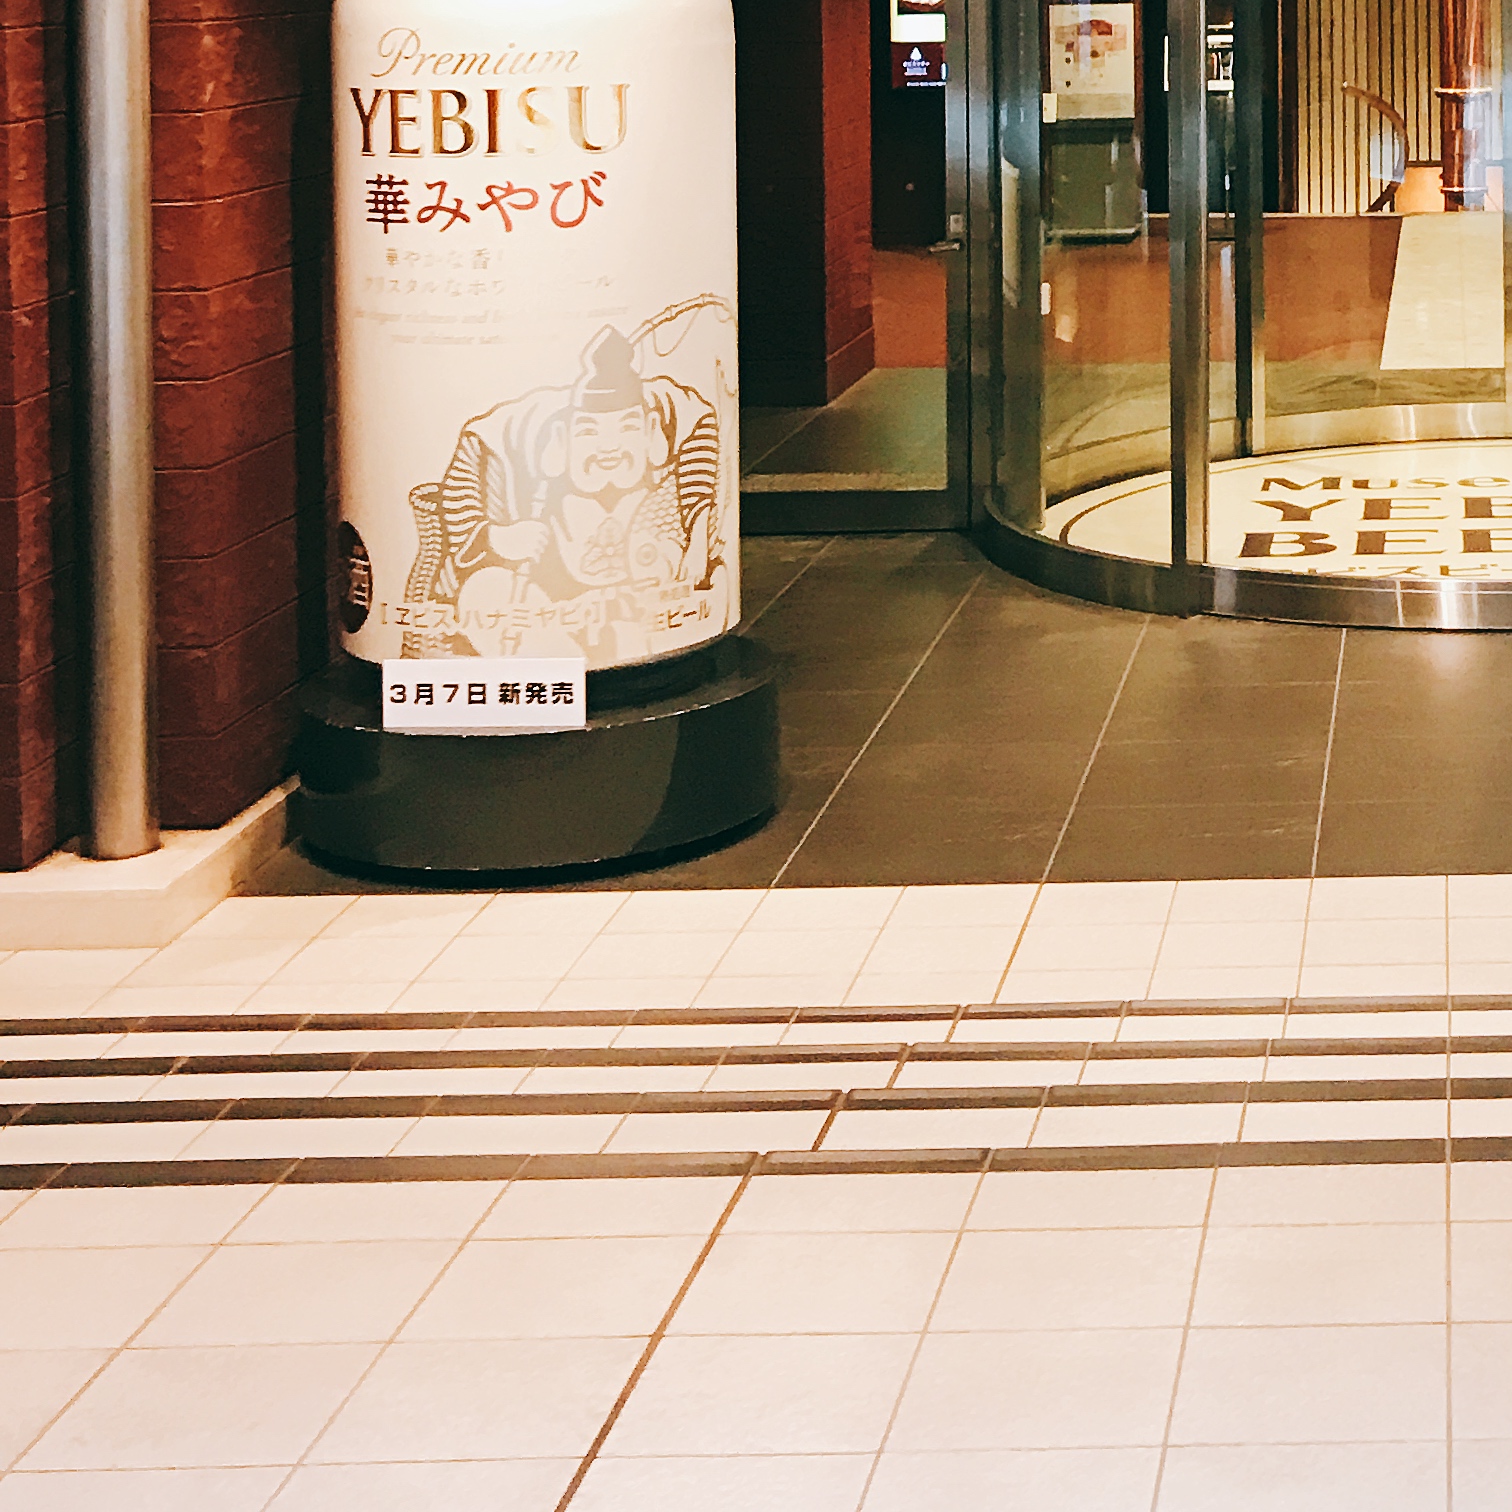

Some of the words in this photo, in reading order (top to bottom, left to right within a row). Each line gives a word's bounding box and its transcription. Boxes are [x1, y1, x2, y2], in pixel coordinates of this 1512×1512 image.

[371, 27, 582, 78] Premium
[350, 84, 630, 158] YEBISU
[365, 171, 608, 234] 華みやび
[390, 683, 487, 705] 3月7日
[498, 682, 575, 705] 新発売
